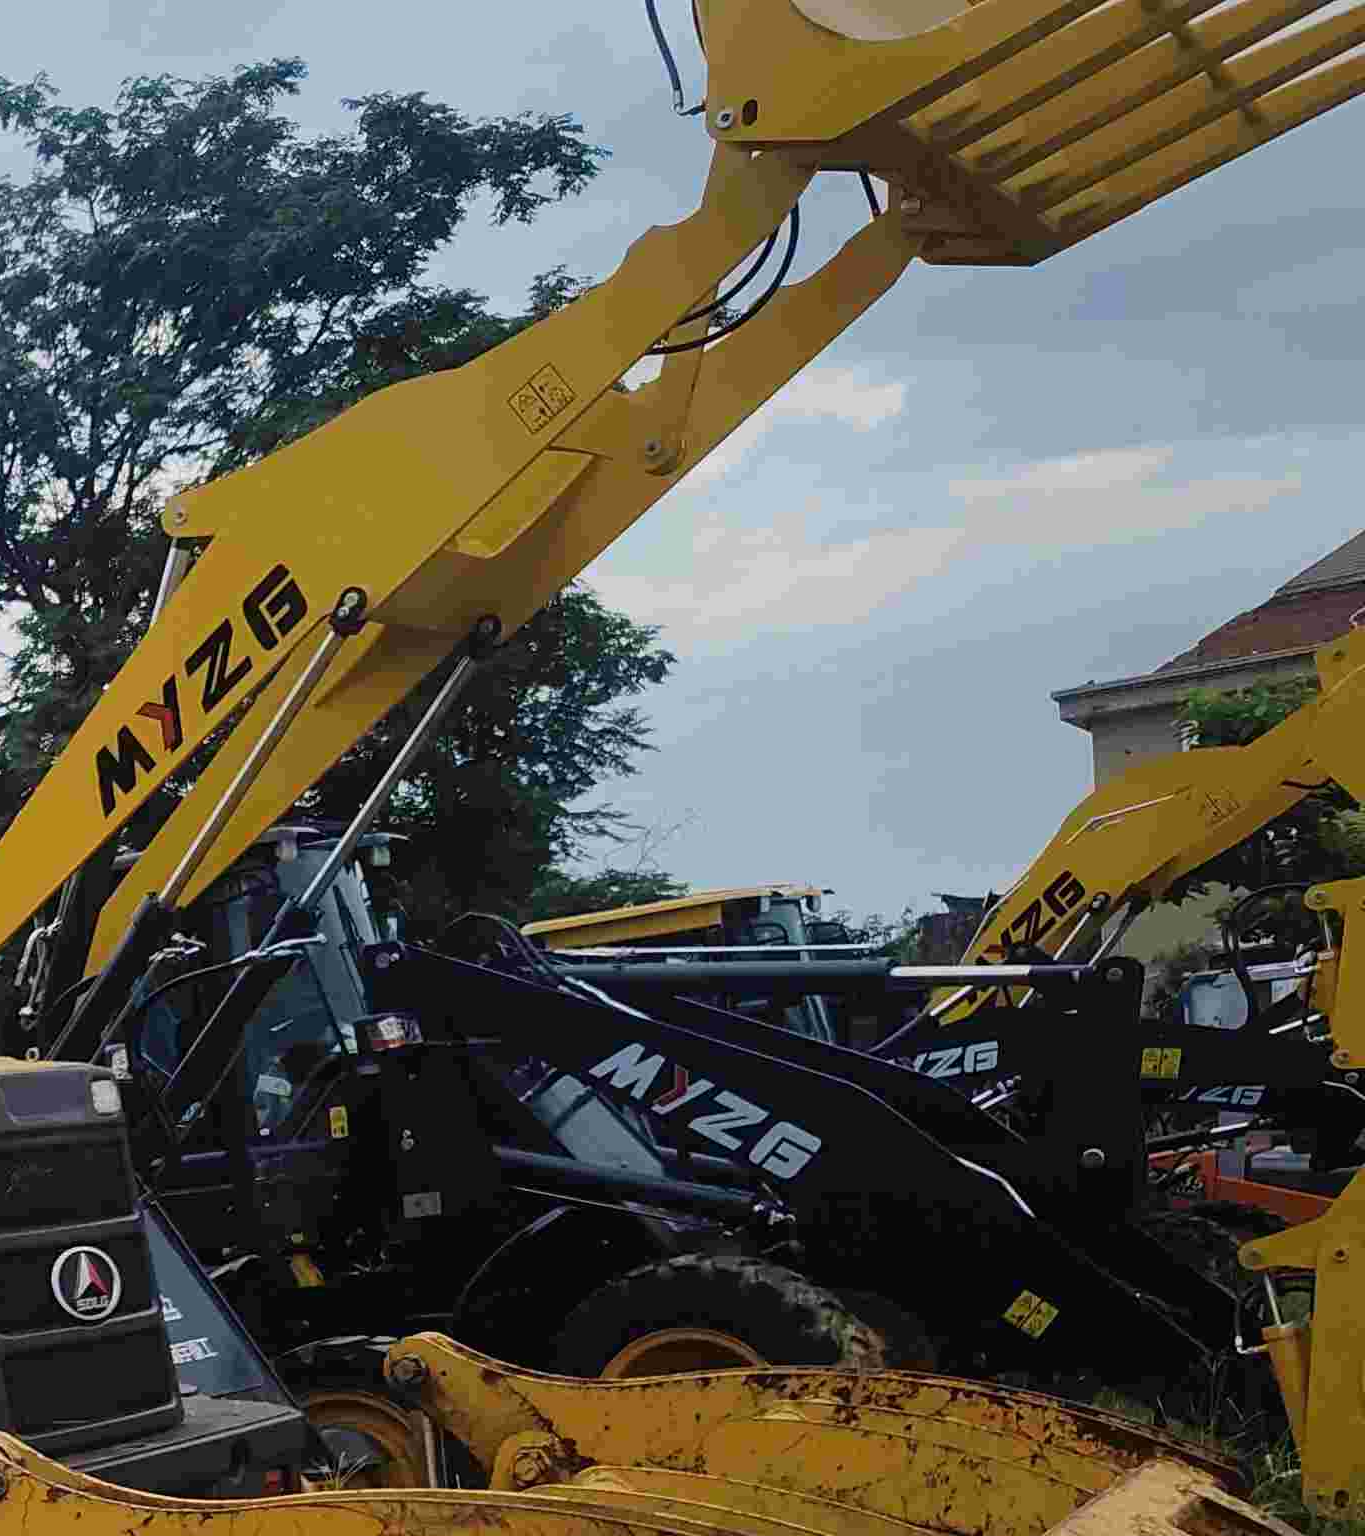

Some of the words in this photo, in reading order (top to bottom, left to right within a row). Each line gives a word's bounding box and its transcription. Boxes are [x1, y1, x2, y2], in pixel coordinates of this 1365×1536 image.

[95, 563, 309, 817] MYZG
[588, 1043, 821, 1180] MYZG
[77, 1295, 110, 1311] SDLG
